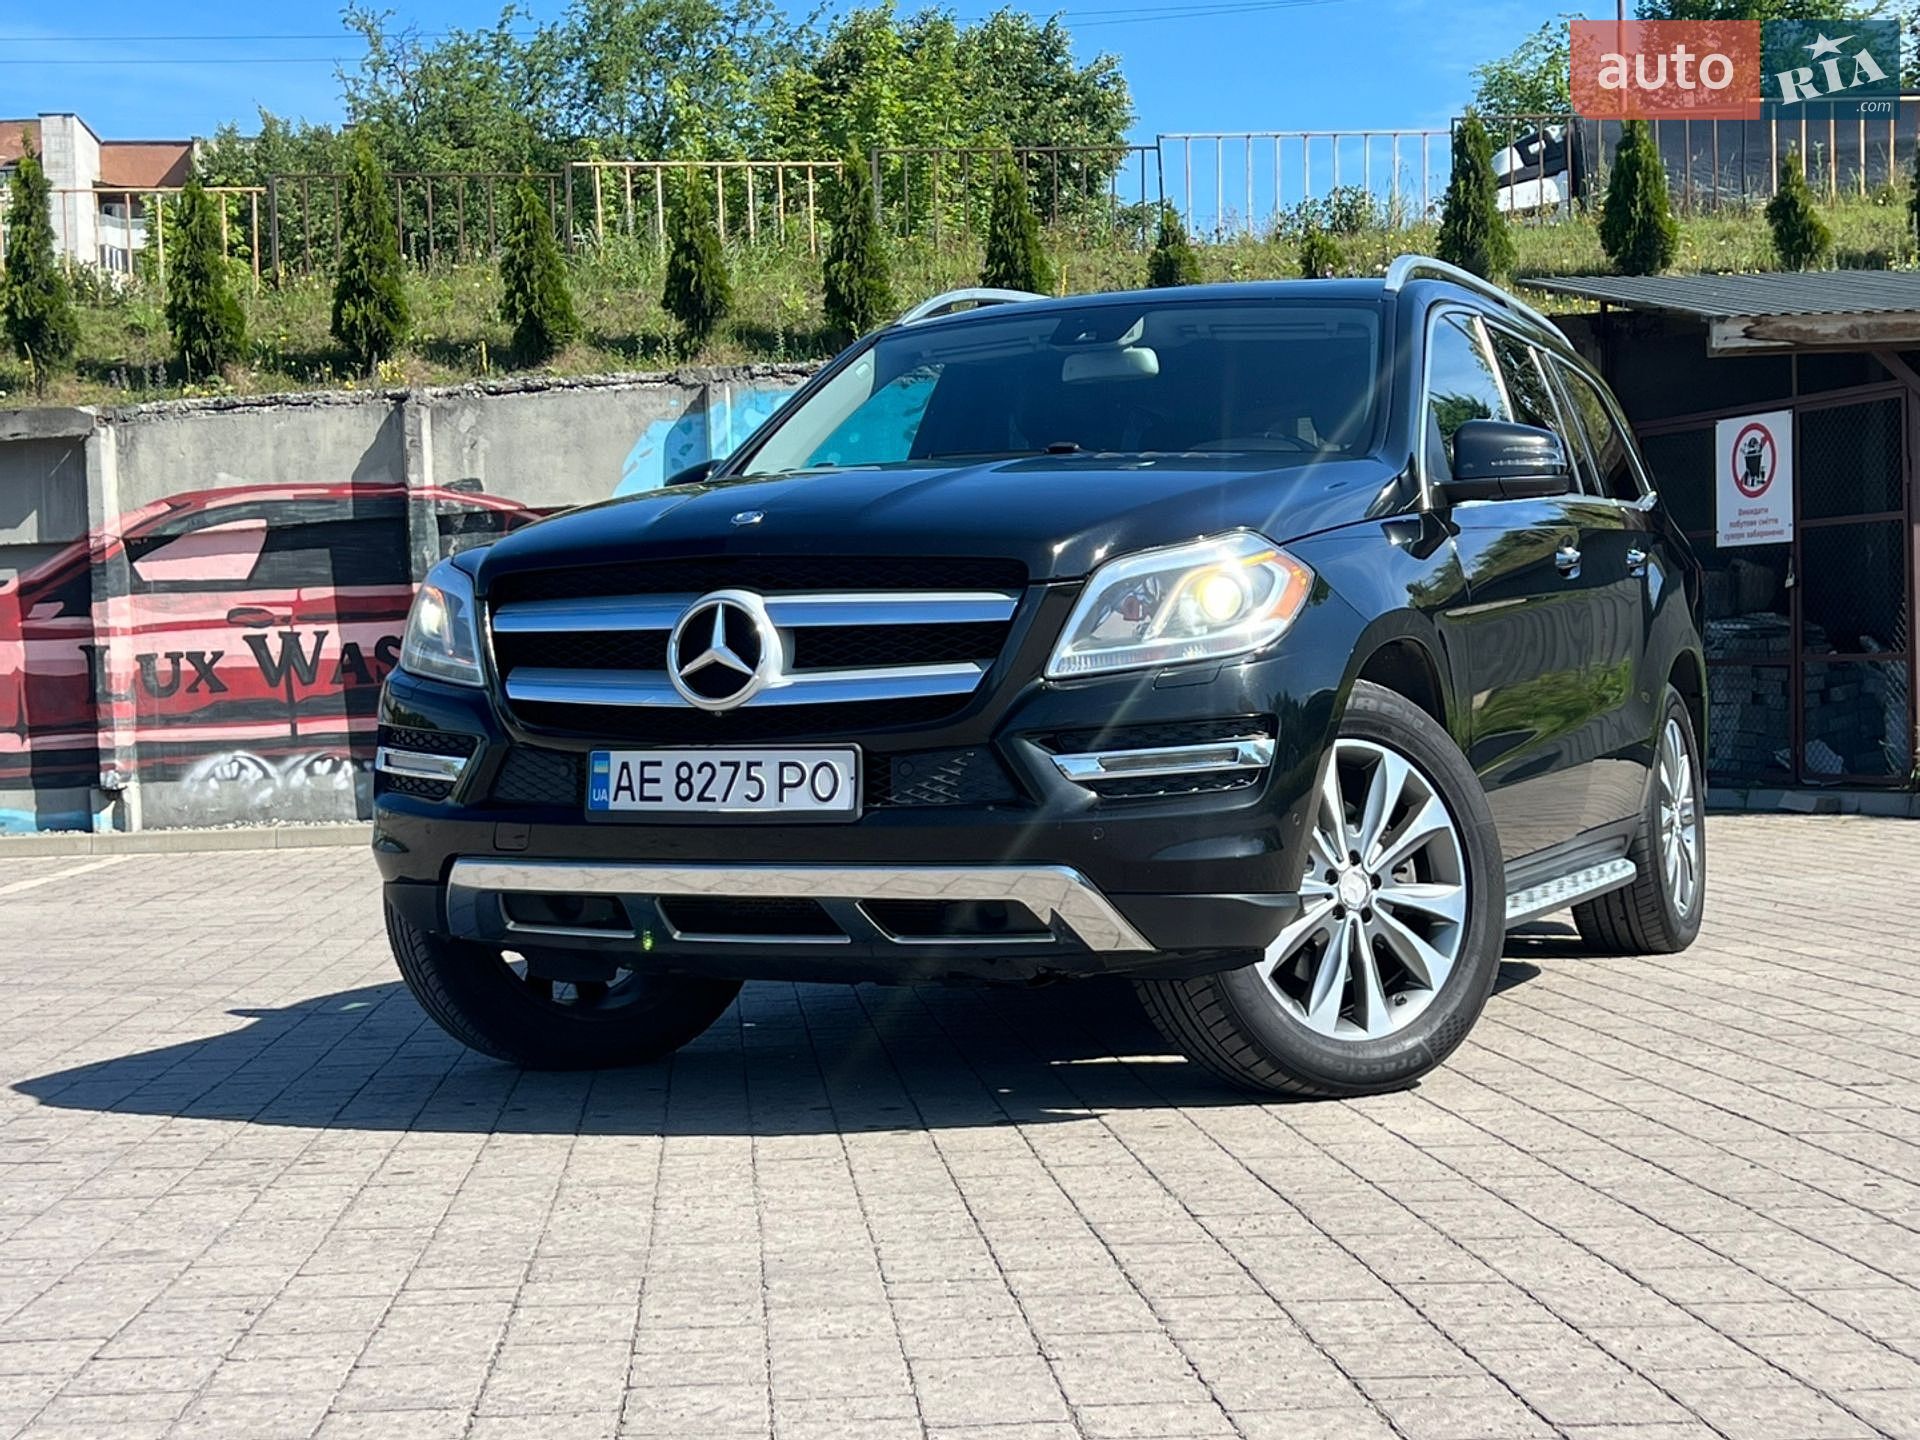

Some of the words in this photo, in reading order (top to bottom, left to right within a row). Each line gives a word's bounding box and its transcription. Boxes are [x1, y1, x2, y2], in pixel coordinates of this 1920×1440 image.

[243, 630, 403, 687] WAS
[592, 788, 608, 801] UA
[613, 760, 663, 803] AE
[674, 760, 766, 803] 8275
[778, 760, 841, 803] PO
